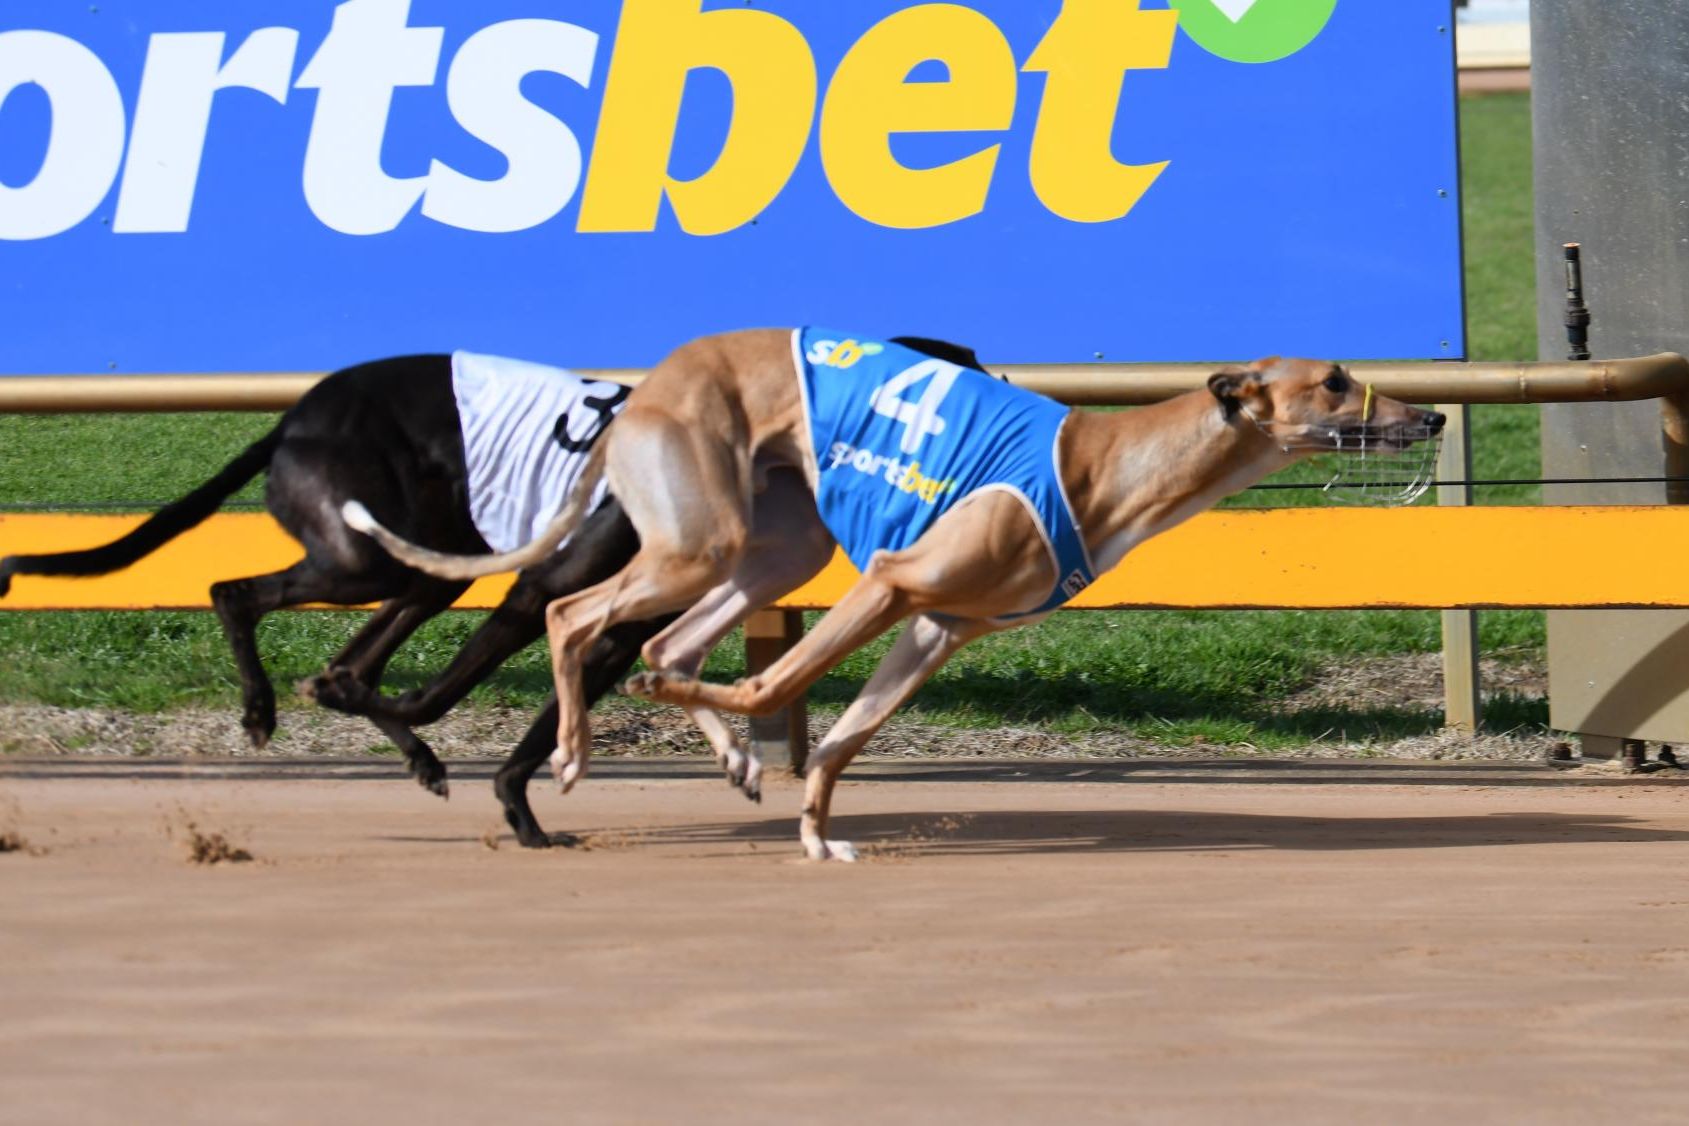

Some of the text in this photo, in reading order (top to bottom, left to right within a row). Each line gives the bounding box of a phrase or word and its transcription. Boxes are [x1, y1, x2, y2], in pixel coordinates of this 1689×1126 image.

[806, 339, 864, 369] sb
[553, 378, 633, 454] 3
[869, 359, 965, 454] 4
